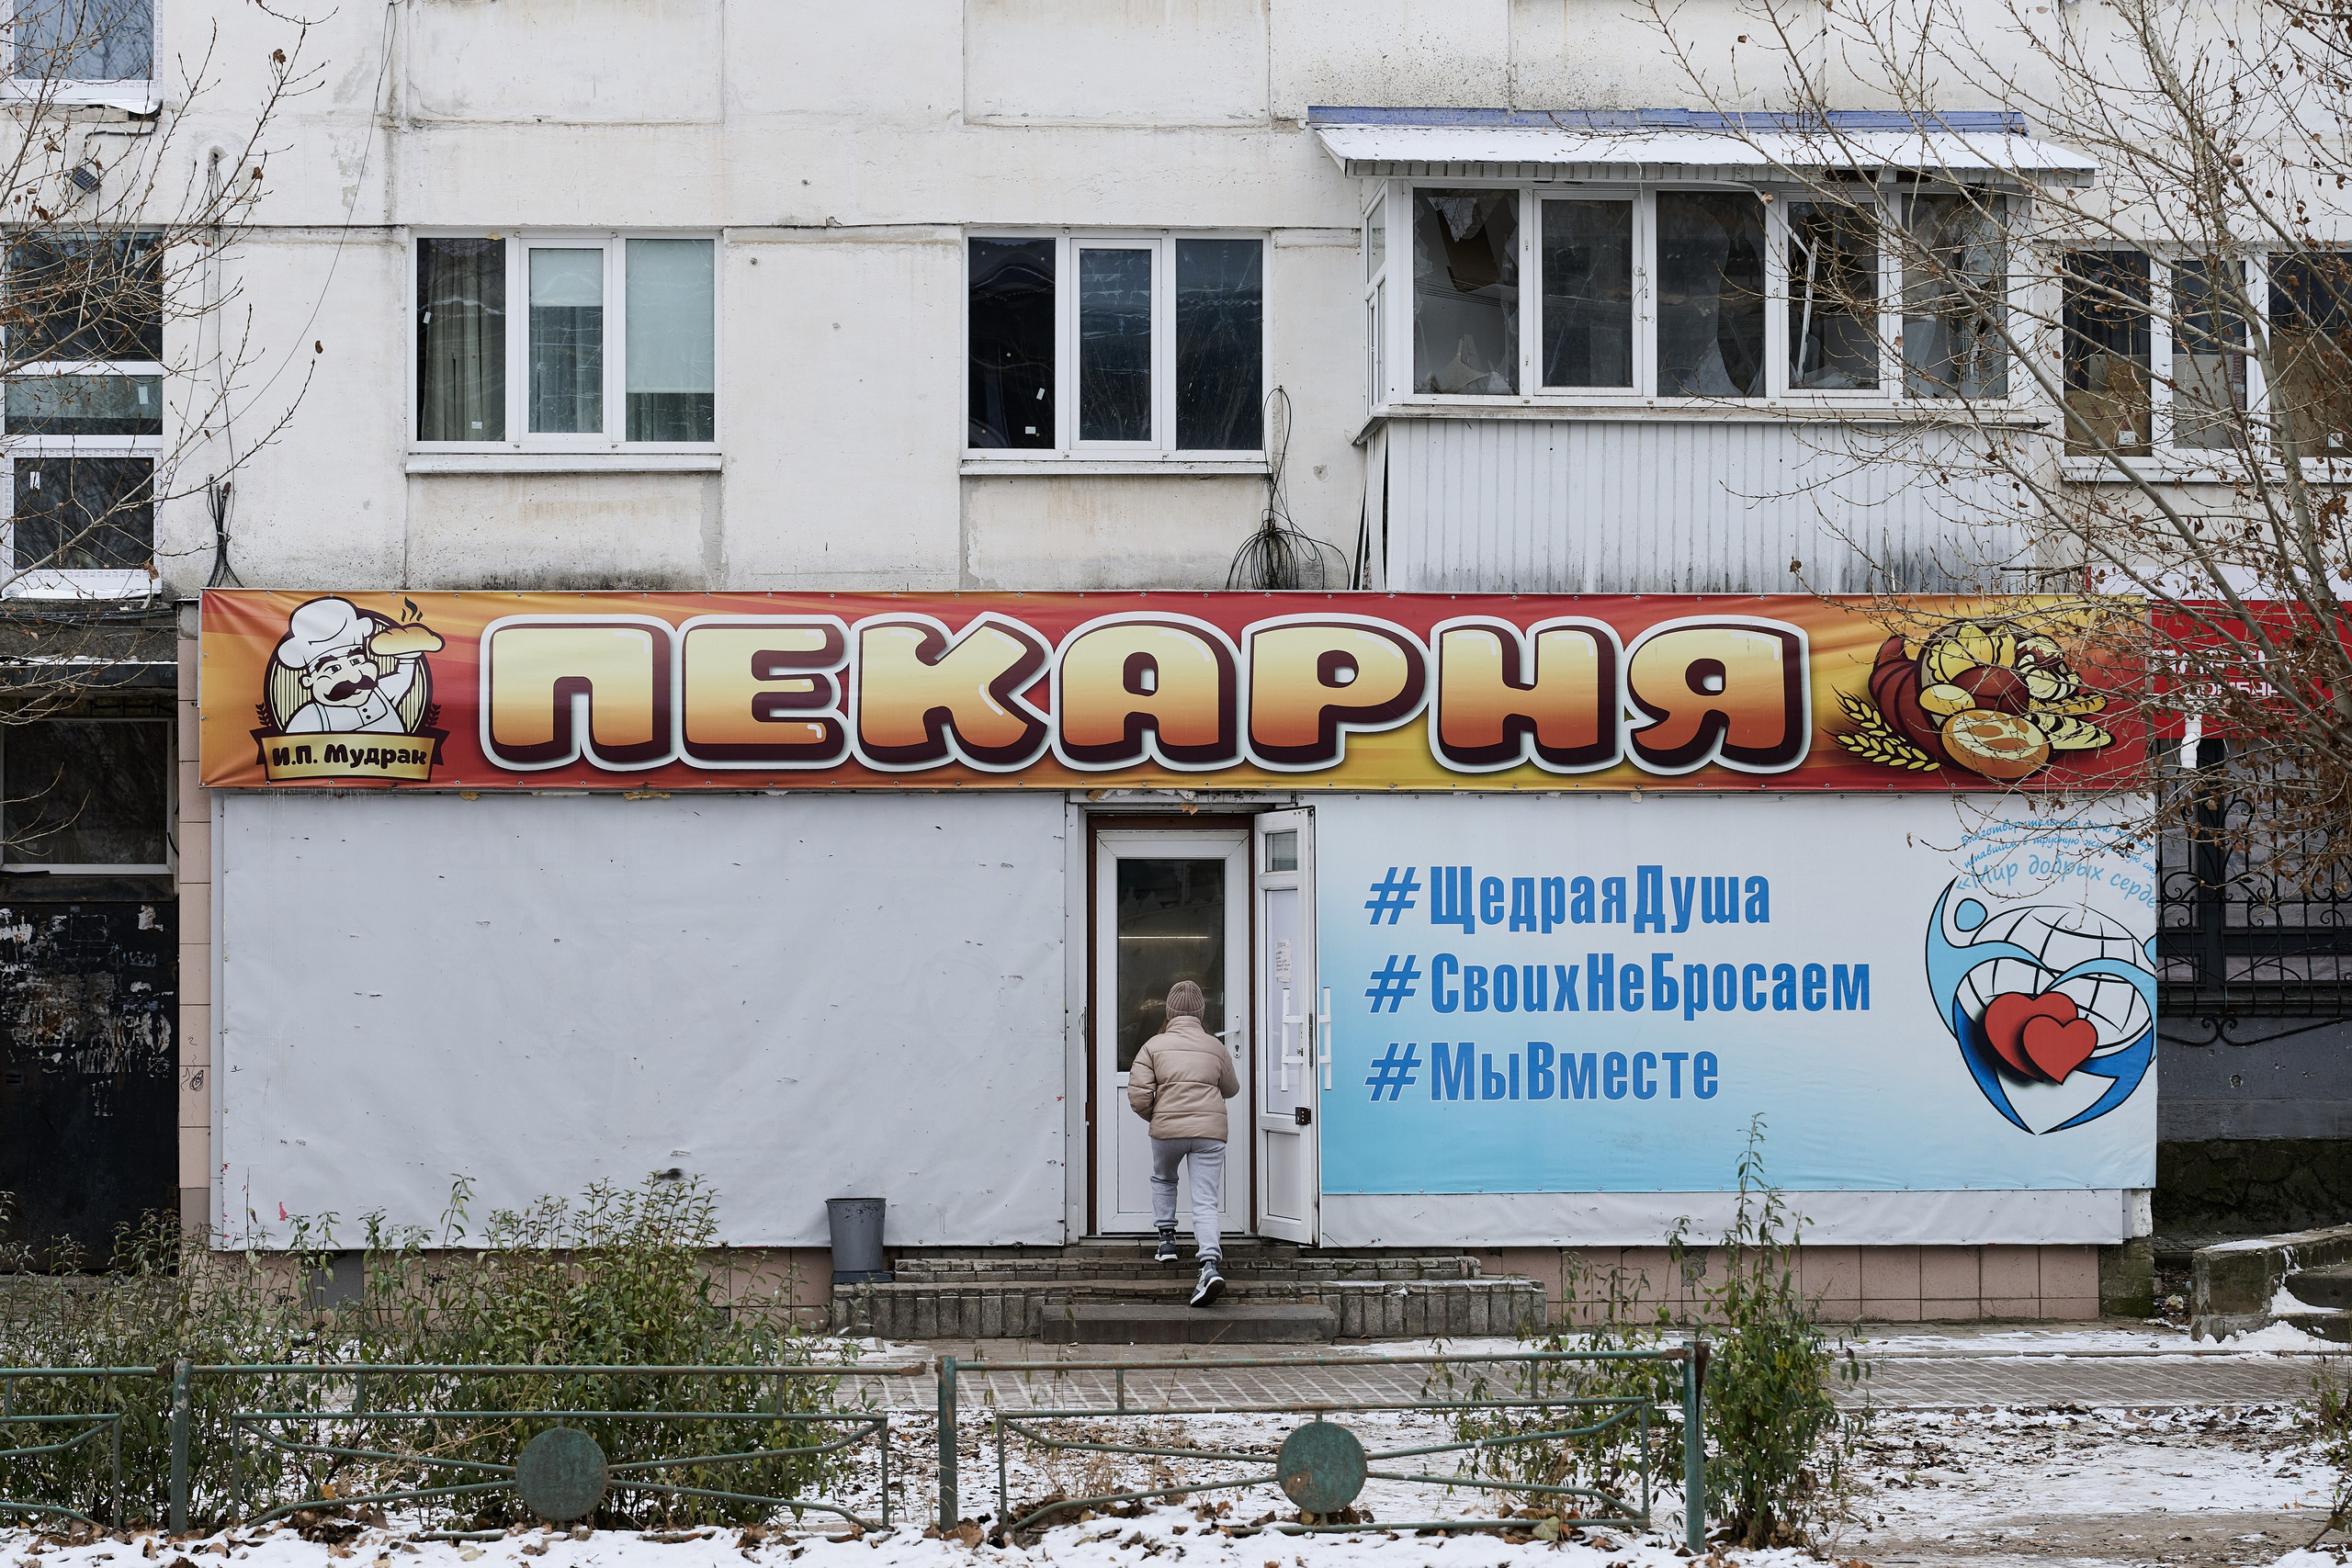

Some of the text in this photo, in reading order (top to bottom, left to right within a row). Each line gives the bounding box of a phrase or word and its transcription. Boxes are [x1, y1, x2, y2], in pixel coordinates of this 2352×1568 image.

[479, 612, 1811, 775] ПЕКАРНЯ
[271, 743, 427, 770] И.П. Мудрак
[1363, 864, 1771, 935] #ЩедраяДуша
[2029, 852, 2105, 883] добрых
[1363, 952, 1871, 1021] #СвоихНеБросаем
[1363, 1040, 1720, 1102] #МыВместе
